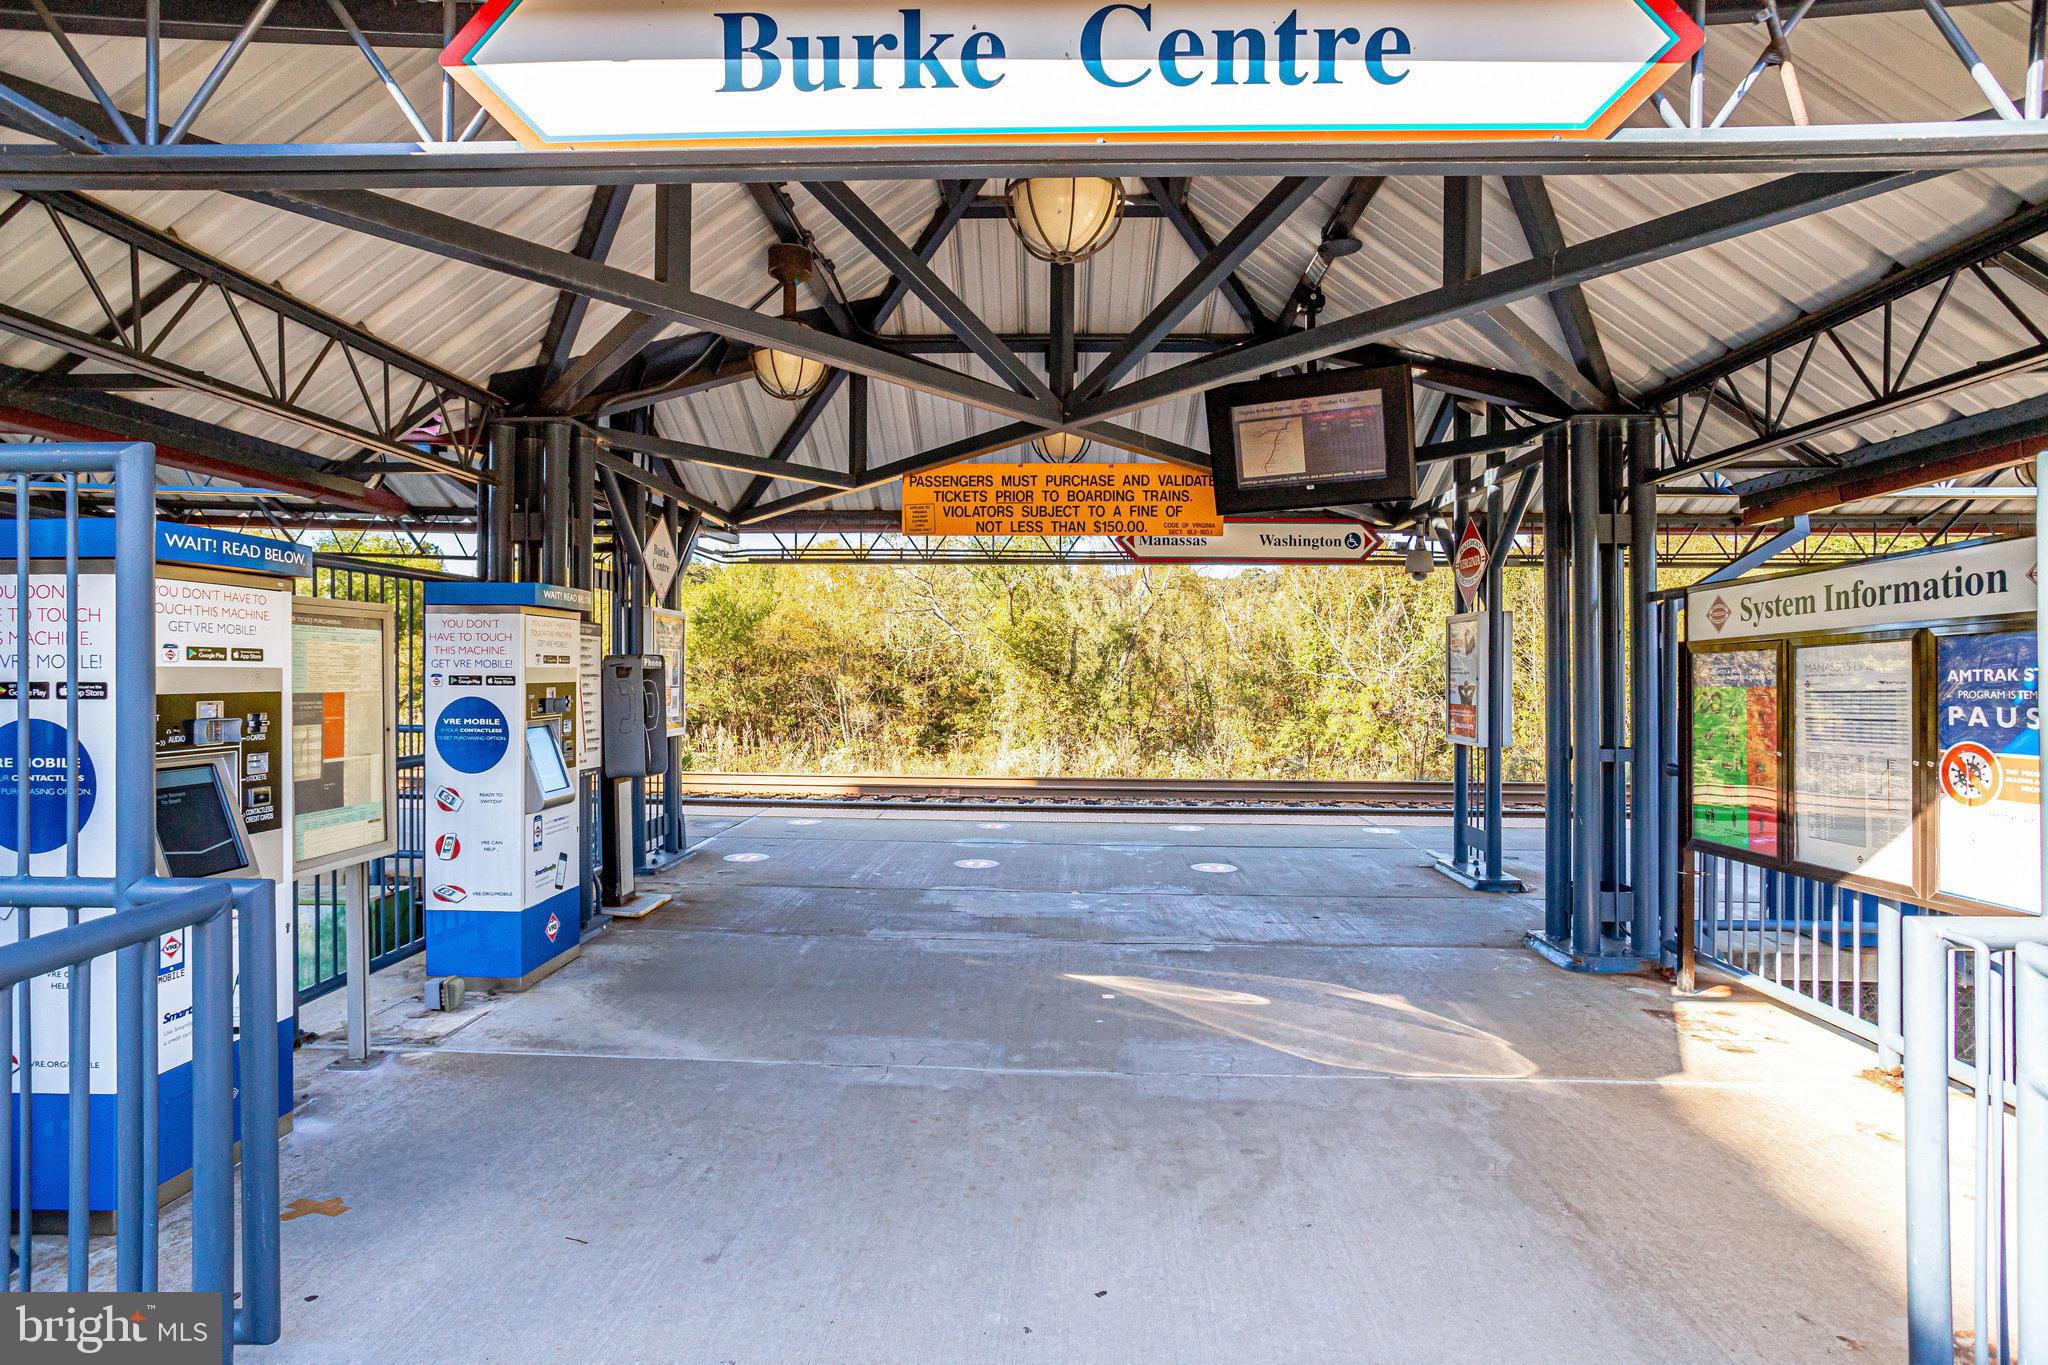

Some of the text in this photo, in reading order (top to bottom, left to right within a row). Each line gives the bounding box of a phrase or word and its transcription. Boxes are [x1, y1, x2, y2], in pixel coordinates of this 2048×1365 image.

[715, 4, 1419, 93] Burke Centre
[909, 475, 1215, 487] PASSENGERS MUST PURCHASE AND VALIDATE
[934, 490, 1193, 503] TICKETS PRIOR TO BOARDING TRAINS.
[943, 506, 1184, 517] VIOLATORS SUBJECT TO A FINE OF
[976, 520, 1148, 533] NOT LESS THAN $150.00.
[1139, 536, 1207, 546] Manassas
[1259, 534, 1342, 550] Washington
[164, 532, 307, 566] WAIT! READ BELOW.
[653, 543, 669, 558] Burke
[652, 559, 670, 573] Centre
[1459, 555, 1481, 570] VIRGINIA
[155, 585, 267, 605] OU DON'T HAVE TO
[543, 590, 577, 602] WAIT! READ
[1740, 594, 1816, 628] System
[1824, 565, 2009, 612] Information
[155, 602, 271, 621] OUCH THIS MACHINE.
[168, 620, 257, 636] GET VRE MOBILE!
[441, 619, 500, 628] YOU DON'T
[429, 633, 512, 642] HAVE TO TOUCH
[434, 646, 507, 655] THIS MACHINE.
[37, 654, 102, 669] MOLE!
[431, 659, 513, 669] GET VRE MOBILE!
[643, 658, 663, 667] Phone
[1804, 661, 1852, 672] MANASSAS
[1947, 668, 2019, 683] AMTRAK
[33, 689, 47, 697] Play
[1958, 690, 2006, 699] PROGRAM
[2008, 690, 2016, 699] IS
[1948, 705, 2040, 730] PAUS
[168, 735, 186, 743] AUDIO
[249, 774, 267, 782] TICKETS
[169, 791, 186, 799] Screen
[245, 805, 274, 816] CONTACTLESS
[245, 812, 274, 824] CREDIT CARDS
[548, 922, 558, 932] VRE
[165, 943, 178, 952] VRE
[158, 968, 186, 983] MOBILE
